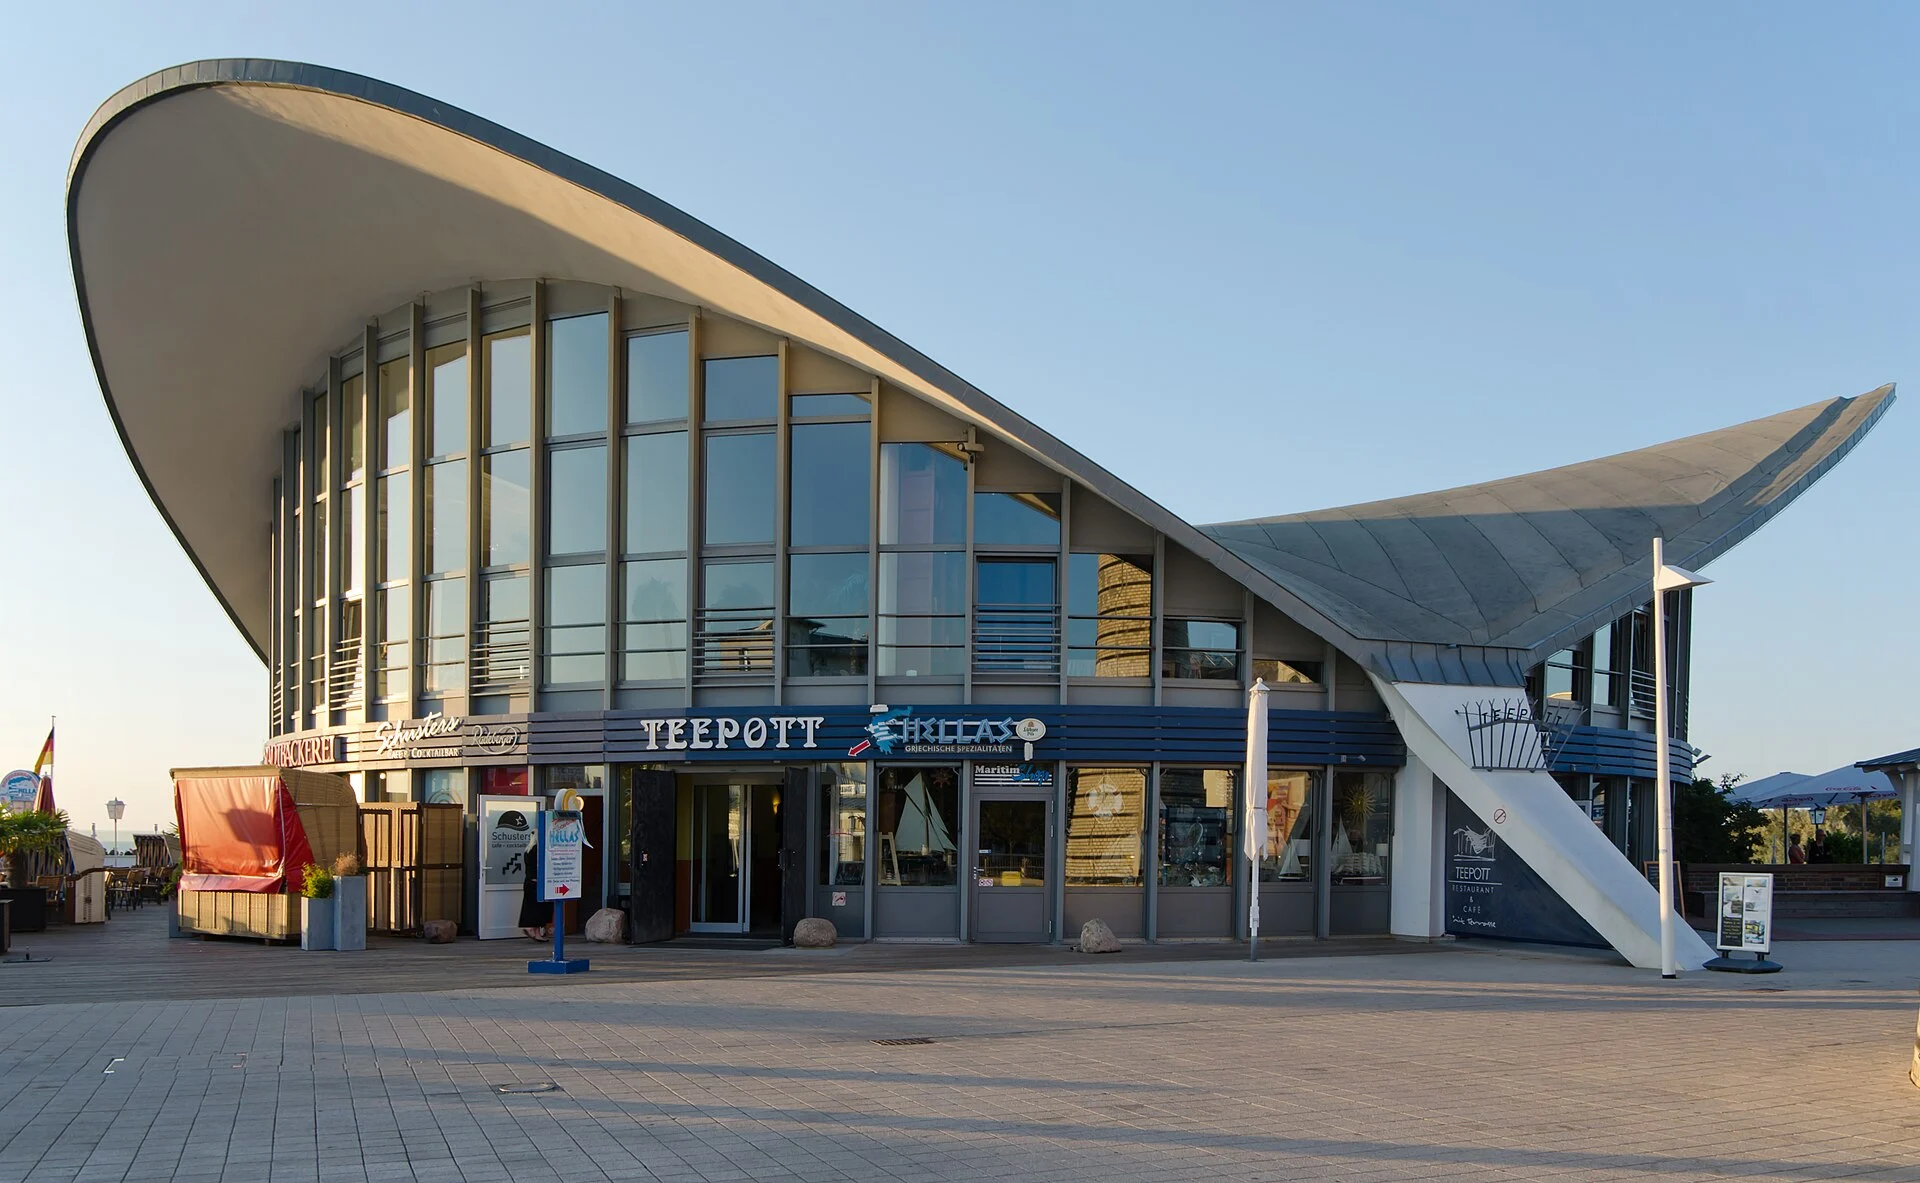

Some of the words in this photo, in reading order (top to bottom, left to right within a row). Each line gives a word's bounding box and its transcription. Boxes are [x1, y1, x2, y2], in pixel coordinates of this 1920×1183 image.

[1482, 709, 1563, 726] TEEPTT
[375, 712, 460, 755] Schusters
[640, 717, 825, 750] TEEPOTT
[902, 716, 1014, 744] HELLAS
[905, 744, 955, 754] GRIECHISCHE
[975, 765, 1020, 775] Maritim
[1012, 764, 1050, 786] Shop
[1455, 866, 1491, 881] TEEPOTT
[1452, 884, 1495, 894] RESTAURANT
